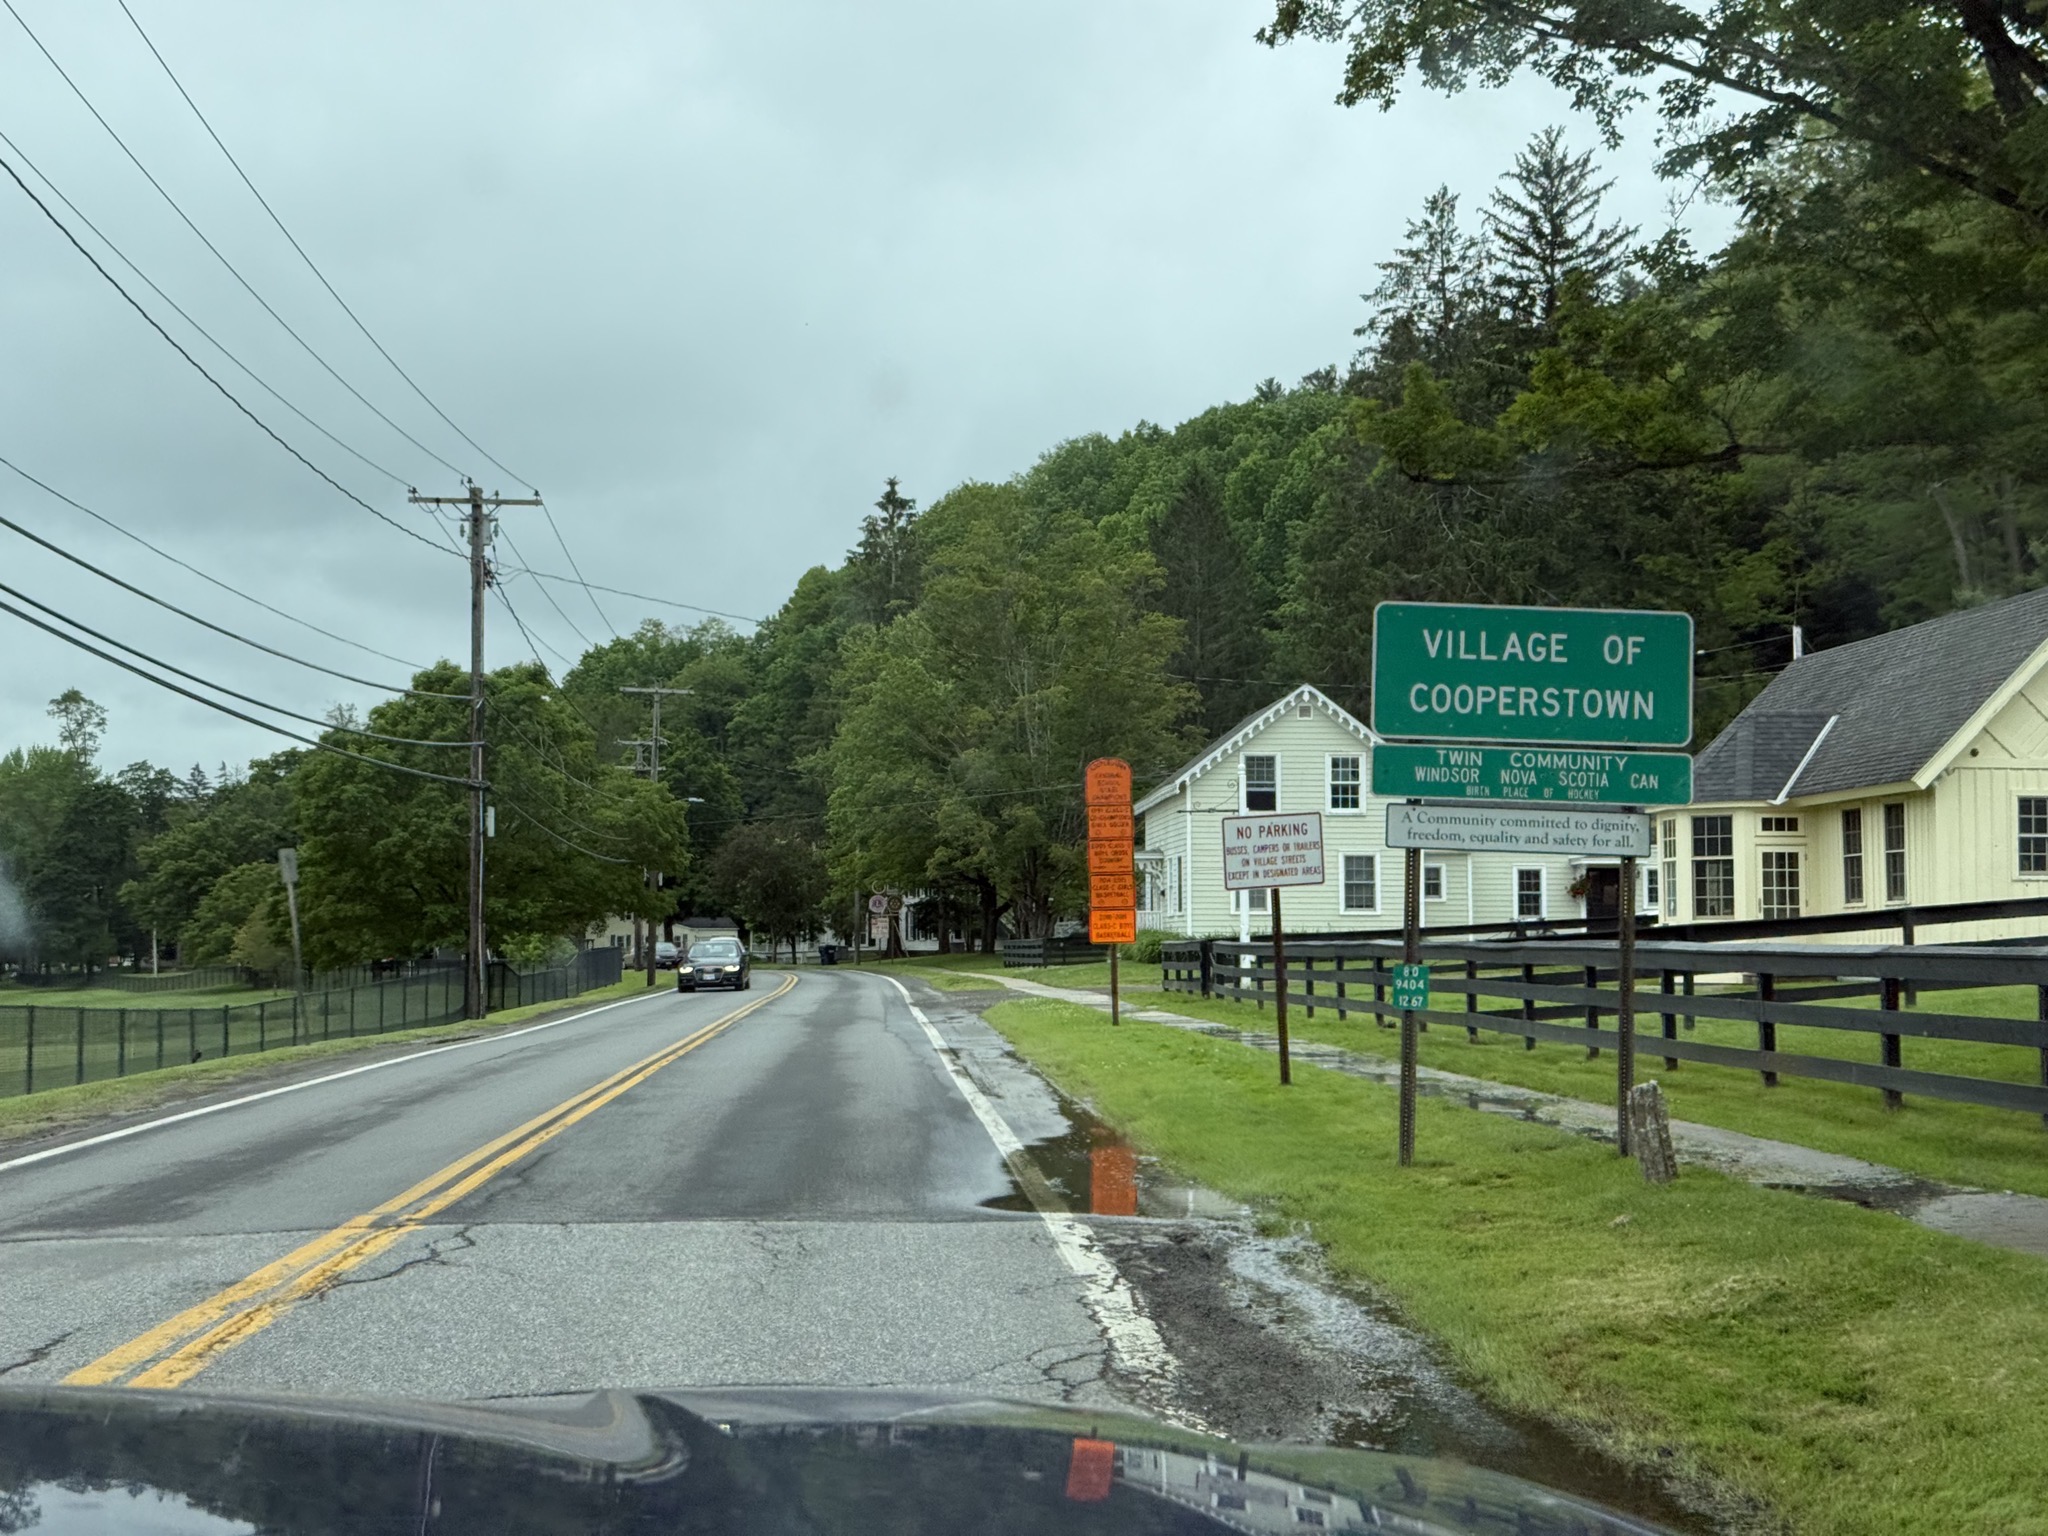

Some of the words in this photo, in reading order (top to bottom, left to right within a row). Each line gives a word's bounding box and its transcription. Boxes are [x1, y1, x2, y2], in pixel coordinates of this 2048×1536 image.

[1422, 629, 1568, 663] VILLAGE
[1603, 635, 1646, 665] OF
[1409, 683, 1655, 720] COOPERSTOWN
[1436, 750, 1483, 767] TWIN
[1510, 752, 1629, 771] COMMUNITY
[1415, 766, 1480, 783] WINDSOR
[1500, 769, 1537, 785] NOVA
[1558, 771, 1609, 788] SCOTIA
[1630, 773, 1659, 789] CAN
[1503, 786, 1529, 798] PLACE
[1544, 787, 1554, 799] OF
[1568, 788, 1600, 800] HOCKEY
[1236, 826, 1252, 839] NO
[1258, 822, 1309, 838] PARKING
[1401, 811, 1413, 823] A
[1417, 811, 1497, 828] Community
[1500, 815, 1571, 830] committed
[1574, 819, 1588, 830] to
[1591, 818, 1640, 833] dignity,
[1407, 827, 1466, 843] freedom,
[1469, 829, 1521, 845] equality
[1524, 832, 1549, 845] and
[1552, 834, 1589, 848] safety
[1592, 834, 1611, 848] for
[1614, 835, 1635, 848] all.
[1253, 843, 1280, 854] CAMPERS
[1282, 842, 1291, 852] OR
[1253, 856, 1278, 866] VILLAGE
[1301, 866, 1321, 876] AREAS
[1395, 979, 1425, 990] 9404
[1398, 995, 1424, 1007] 1267
